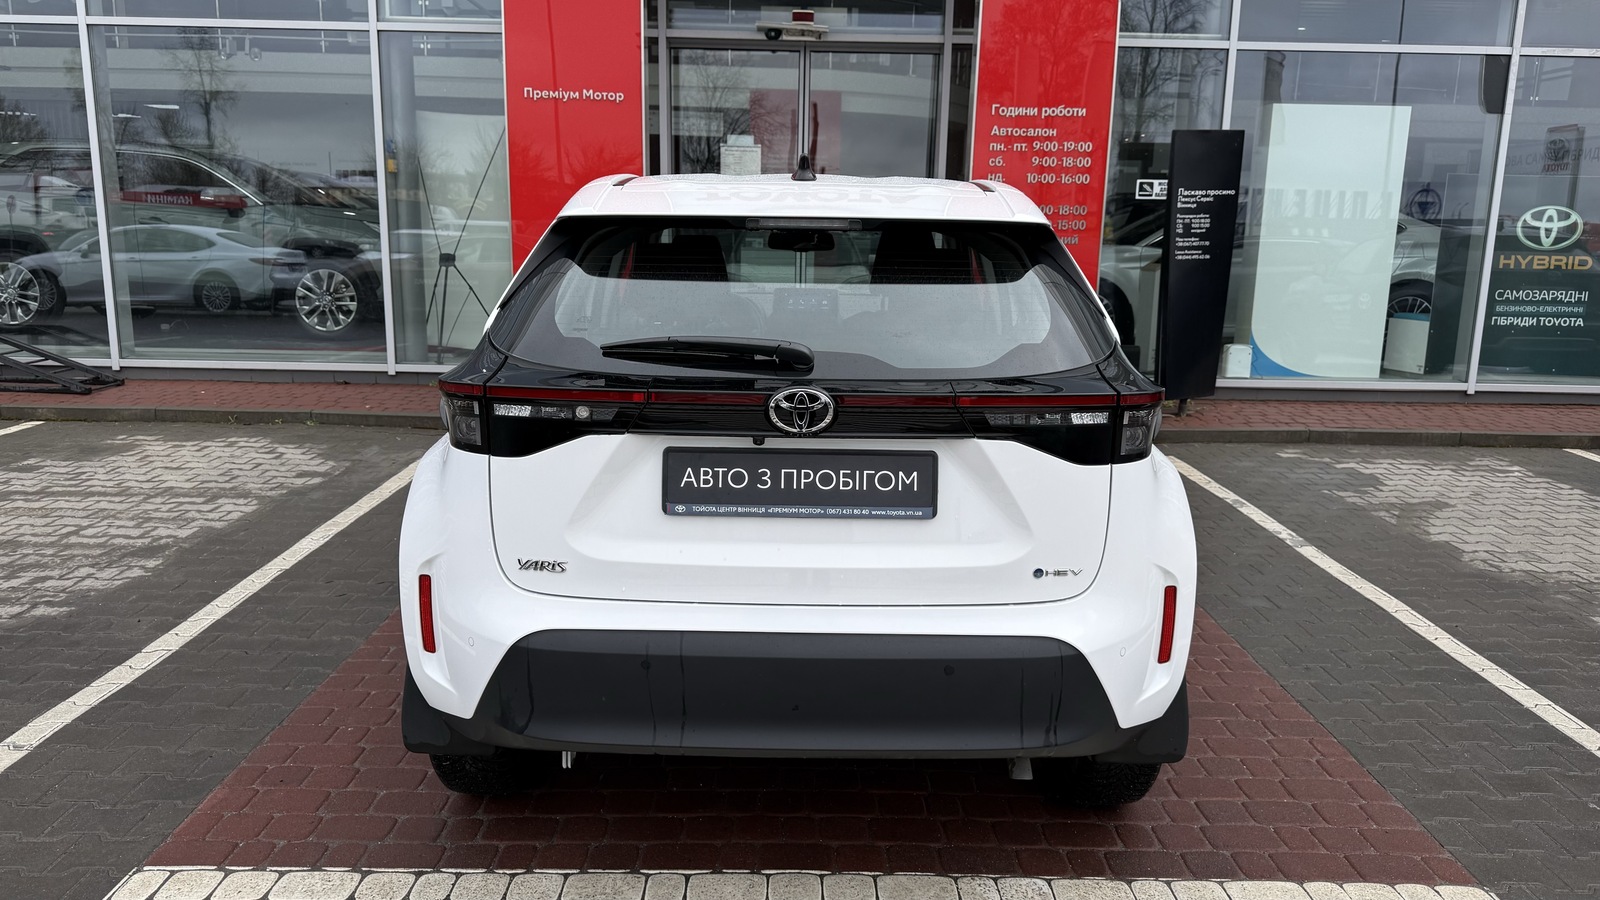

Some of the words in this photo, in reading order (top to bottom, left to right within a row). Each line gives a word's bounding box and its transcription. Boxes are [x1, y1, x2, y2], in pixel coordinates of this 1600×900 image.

[523, 87, 580, 102] Преміум
[582, 89, 625, 103] Мотор
[991, 104, 1038, 117] Години
[1041, 105, 1087, 119] роботи
[990, 125, 1057, 137] Автосалон
[1032, 141, 1092, 152] 9:00-19:00
[988, 156, 1006, 167] сб.
[1031, 156, 1092, 168] 9:00-18:00
[1026, 173, 1091, 185] 10:00-16:00
[1498, 254, 1593, 270] HYBRID
[1494, 289, 1589, 303] САМОЗАРЯДНІ
[1495, 305, 1584, 313] БЕНЗИНОВО-ЕЛЕКТРИЧНІ
[1491, 316, 1537, 327] ГІБРИДИ
[1538, 317, 1585, 327] TOYOTA
[680, 467, 749, 489] АВТО
[780, 468, 919, 492] ПРОБІГОМ
[692, 505, 717, 513] ТОЙОТА
[717, 506, 737, 514] ЦЕНТР
[737, 506, 766, 514] ВІННИЦЯ
[826, 507, 842, 516] (067)
[871, 508, 923, 517] www.toyota.vn.ua
[1045, 568, 1083, 577] HEV
